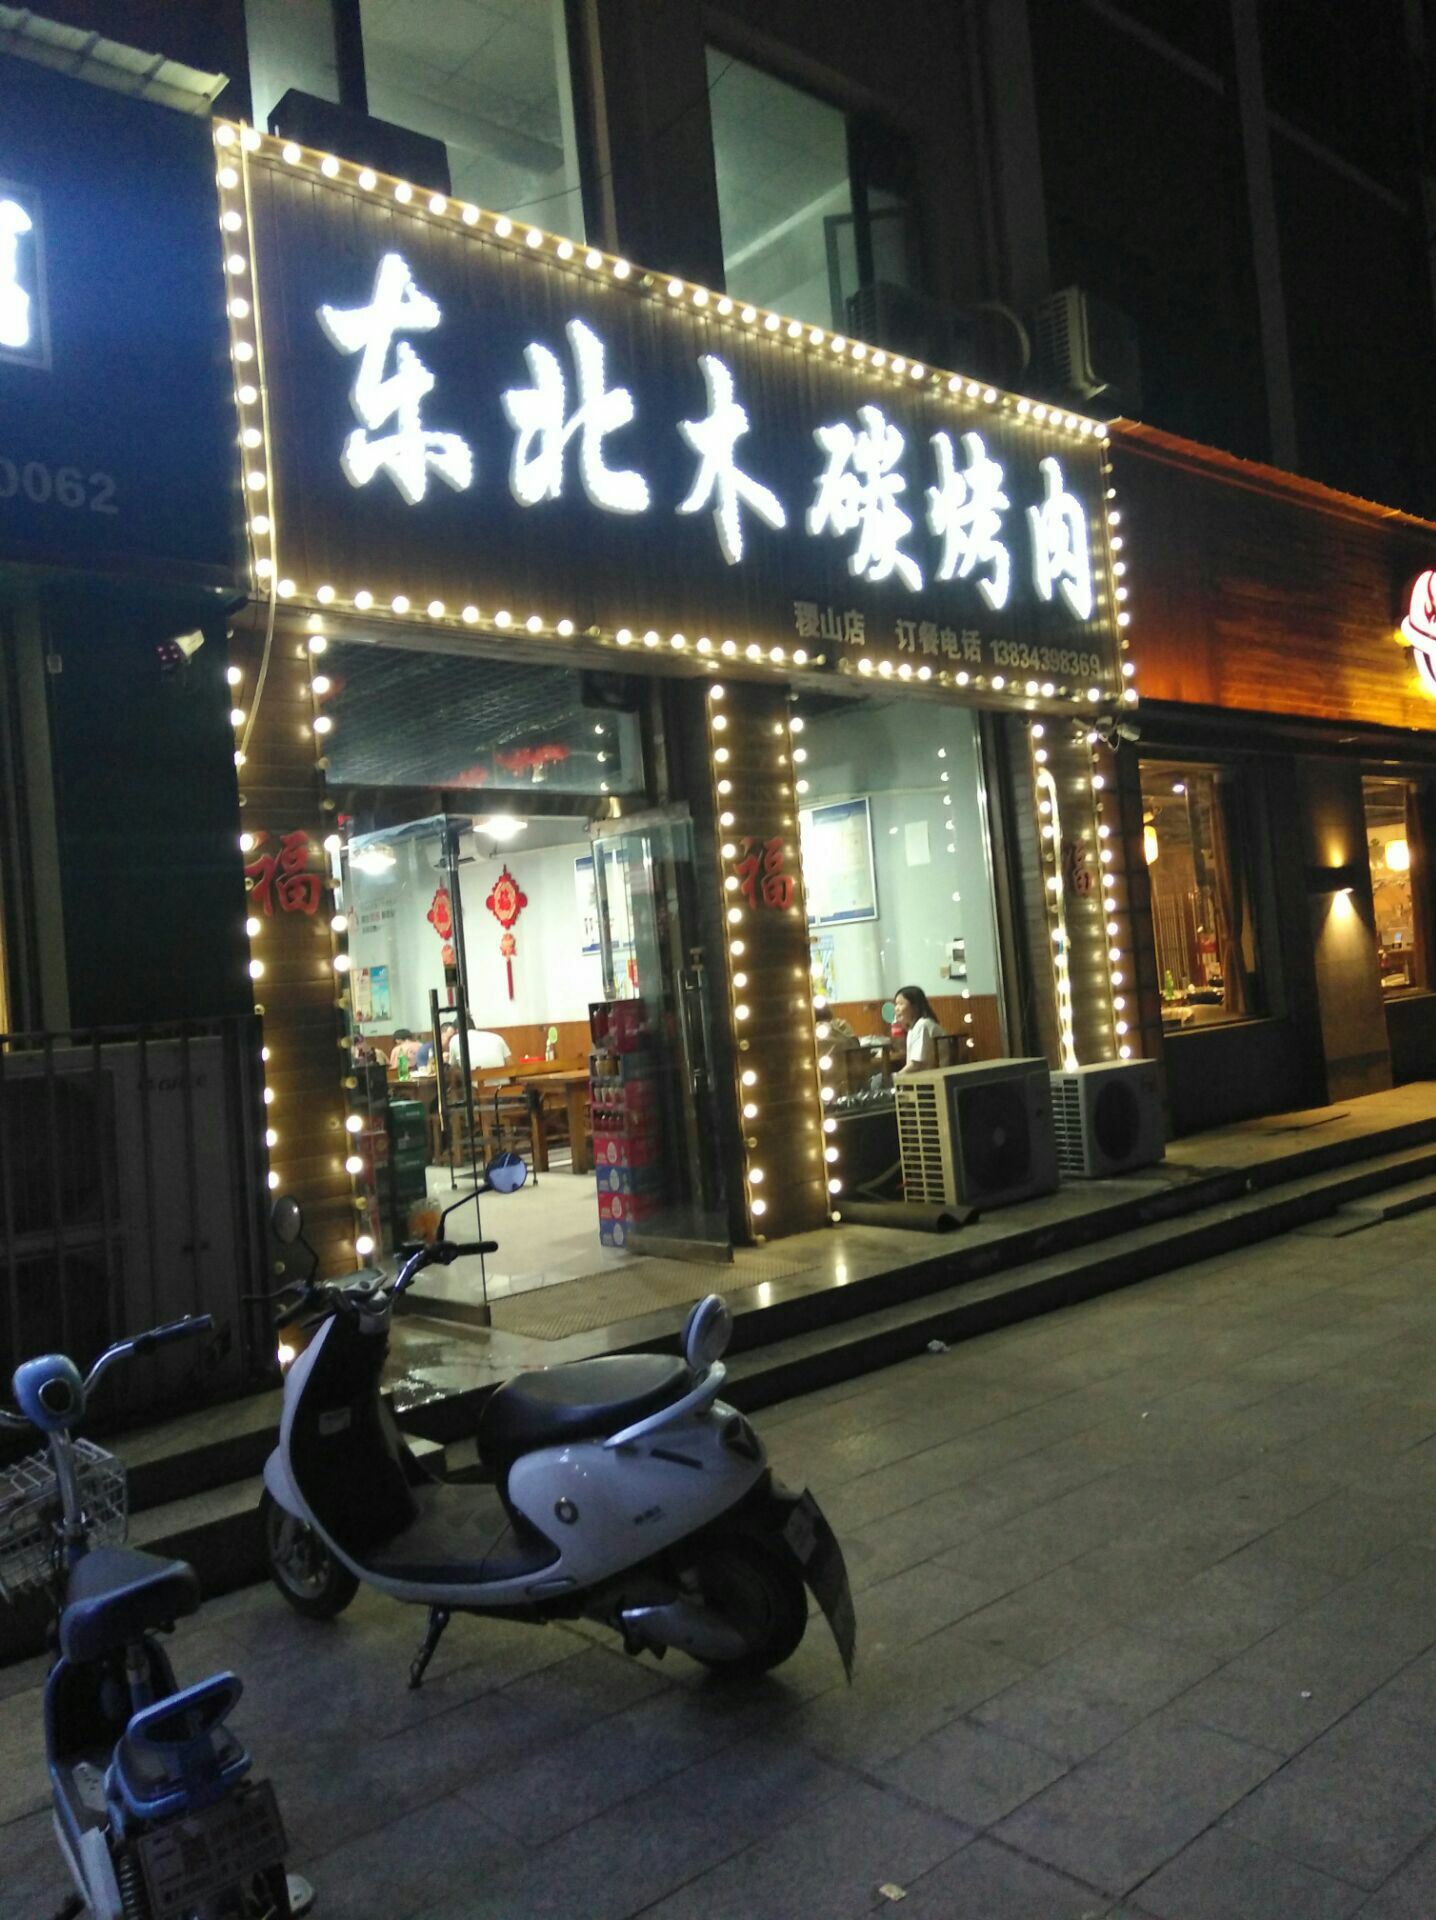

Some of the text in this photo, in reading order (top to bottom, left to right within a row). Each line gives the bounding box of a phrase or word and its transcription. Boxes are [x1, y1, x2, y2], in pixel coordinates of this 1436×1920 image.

[318, 252, 1093, 620] 东北木碳烤肉
[896, 619, 982, 663] 订餐电话
[244, 830, 321, 917] 福
[734, 837, 795, 910] 福
